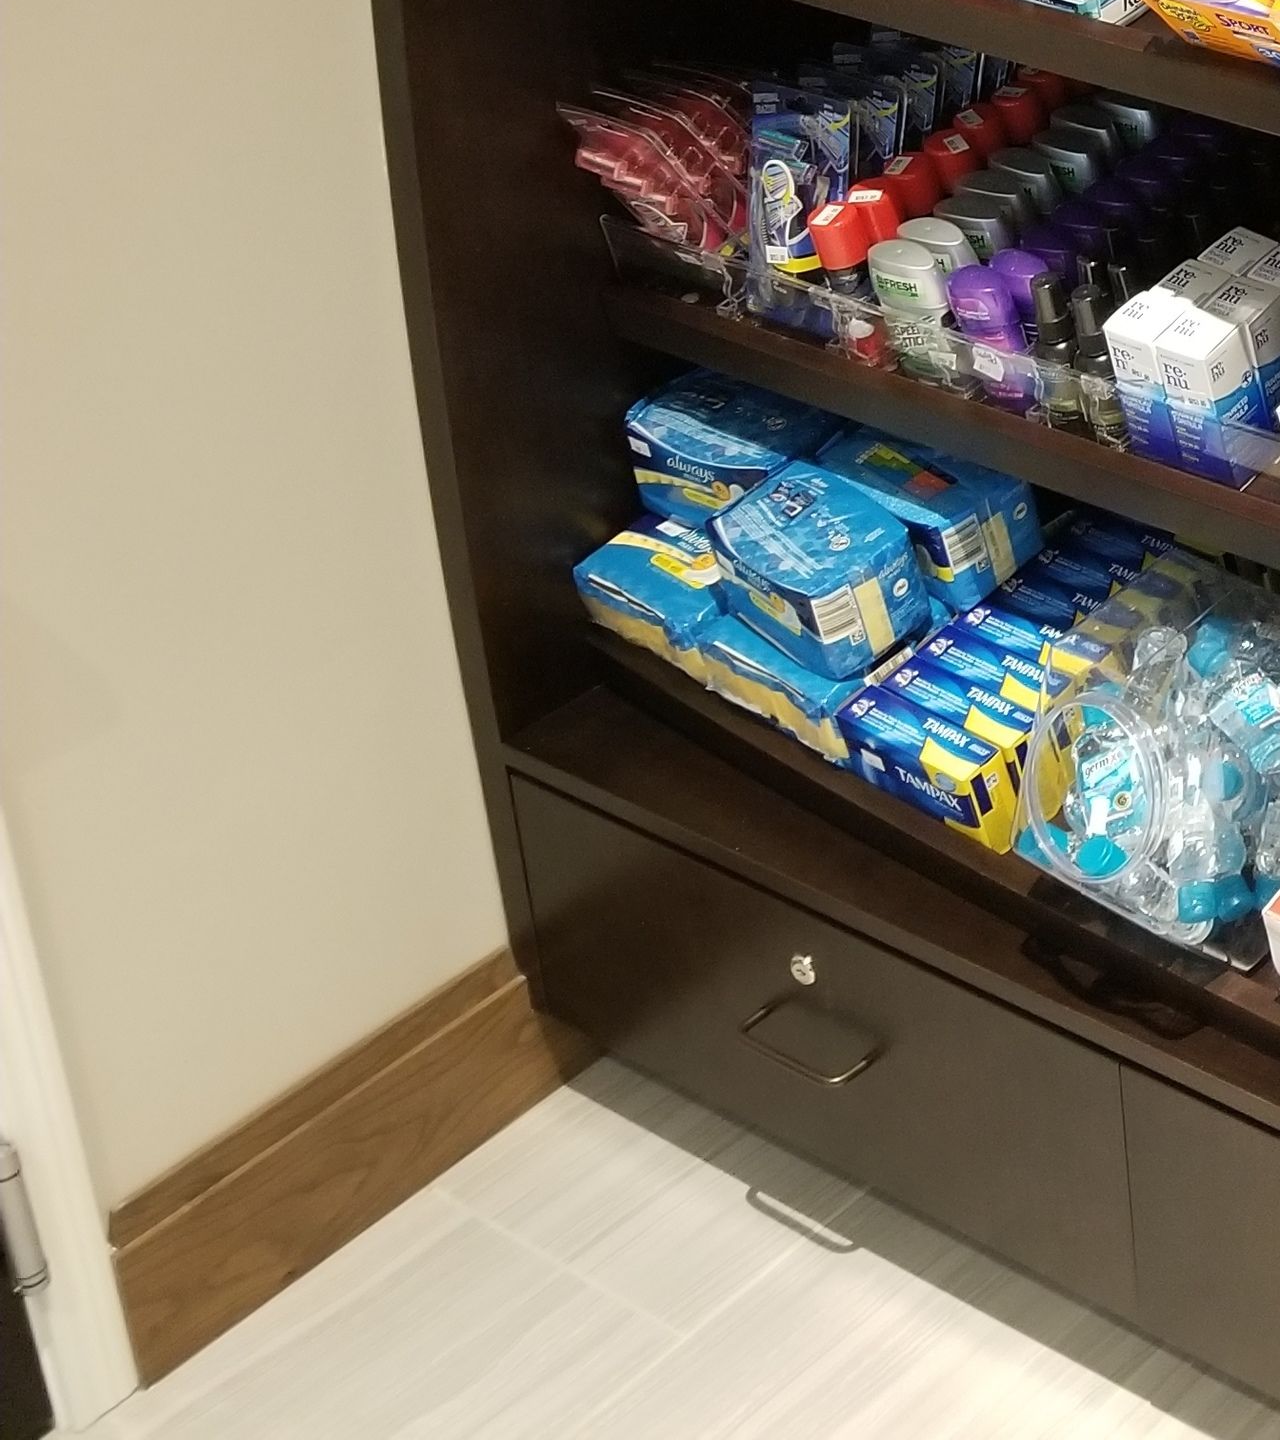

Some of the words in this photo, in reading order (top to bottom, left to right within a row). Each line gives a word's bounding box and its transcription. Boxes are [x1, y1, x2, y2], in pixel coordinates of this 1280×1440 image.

[1215, 13, 1270, 36] SPORT
[1166, 374, 1189, 390] nu
[667, 456, 715, 482] always
[968, 685, 1014, 717] TAMPAX
[922, 716, 972, 749] TAMPAX
[894, 766, 963, 812] TAMPAX
